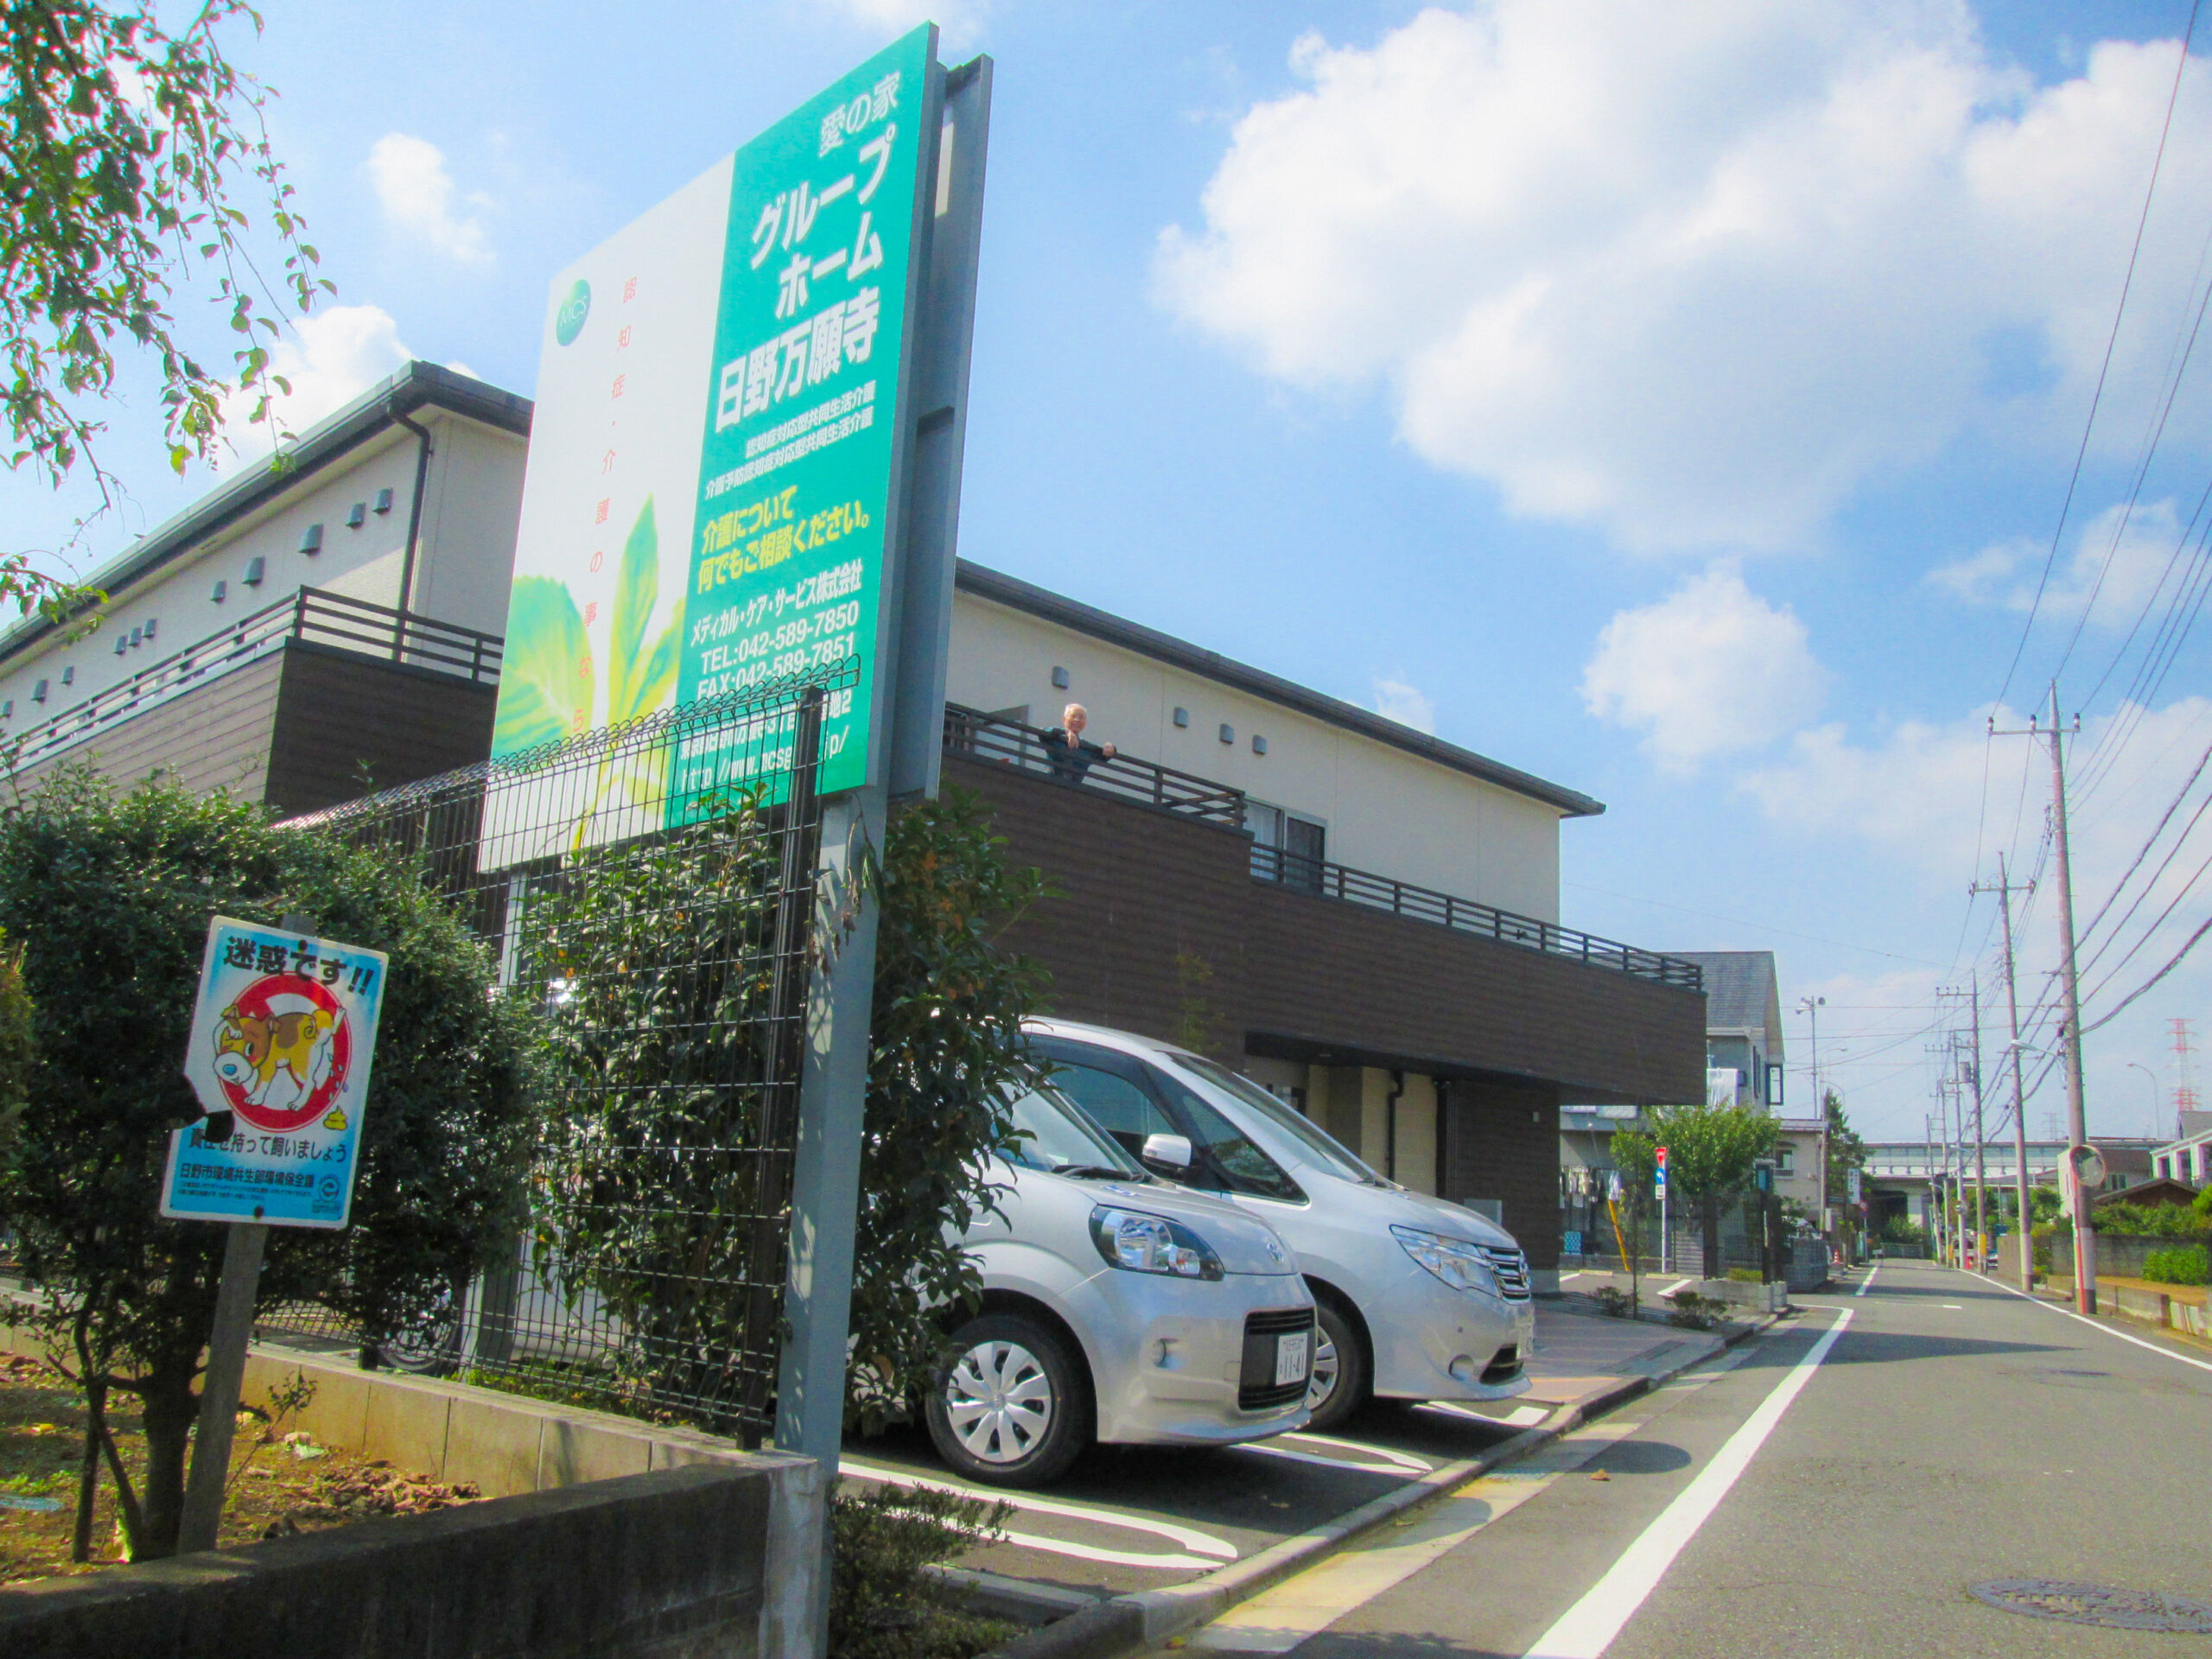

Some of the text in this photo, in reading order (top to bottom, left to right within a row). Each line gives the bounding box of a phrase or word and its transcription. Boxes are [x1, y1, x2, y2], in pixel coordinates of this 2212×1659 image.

[818, 71, 900, 158] 愛の家
[750, 124, 898, 270] グループ
[774, 211, 883, 320] ホーム
[560, 295, 588, 327] MCS
[715, 286, 880, 434] 日野万願寺
[571, 276, 639, 733] 認知症・介護の事なら
[697, 499, 869, 594] 何でもご相談ください。
[702, 484, 798, 556] 介護について
[690, 557, 862, 647] メディカル・ケア・サービス株式会社
[701, 601, 860, 675] TEL:042-589-7850
[696, 632, 855, 702] FAX:042-589-7851
